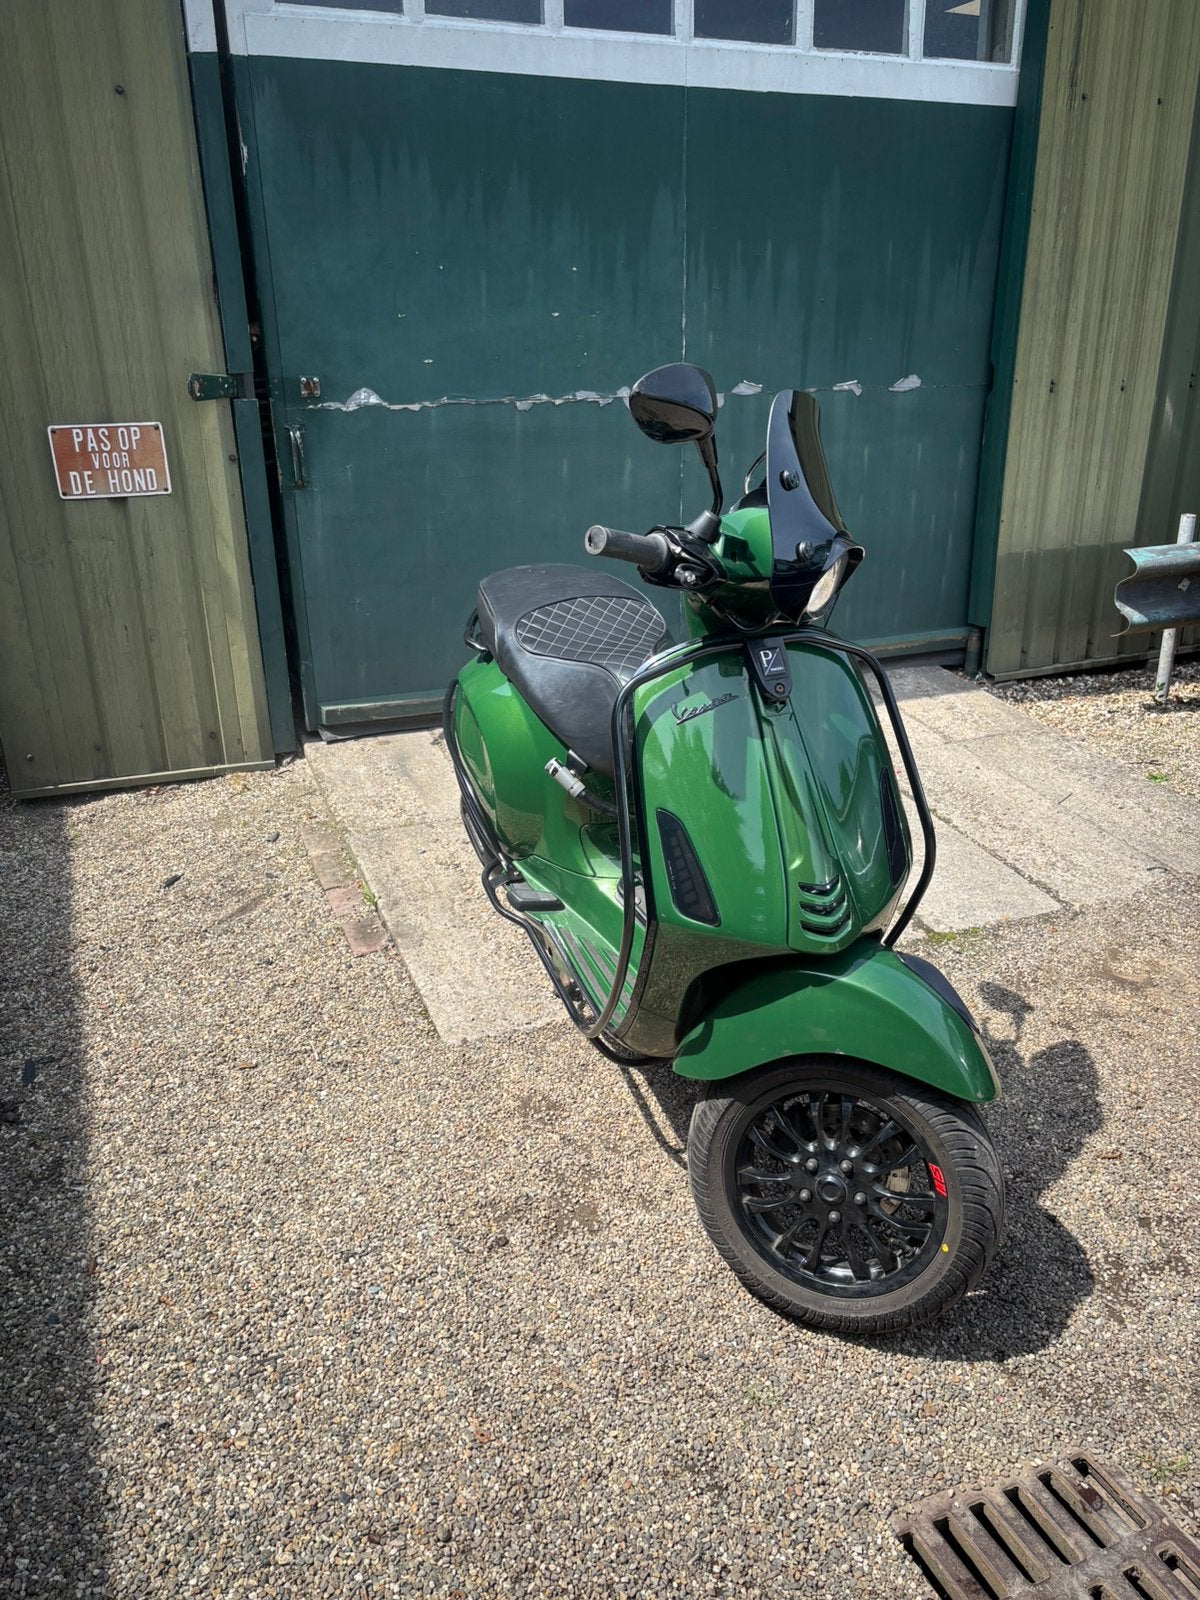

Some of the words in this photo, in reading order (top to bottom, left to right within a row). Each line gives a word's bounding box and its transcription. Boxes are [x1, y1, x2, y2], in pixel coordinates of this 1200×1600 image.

[72, 427, 111, 453] PAS
[117, 427, 141, 451] OP
[91, 452, 130, 470] VOOR
[69, 470, 97, 495] DE
[107, 468, 158, 493] HOND
